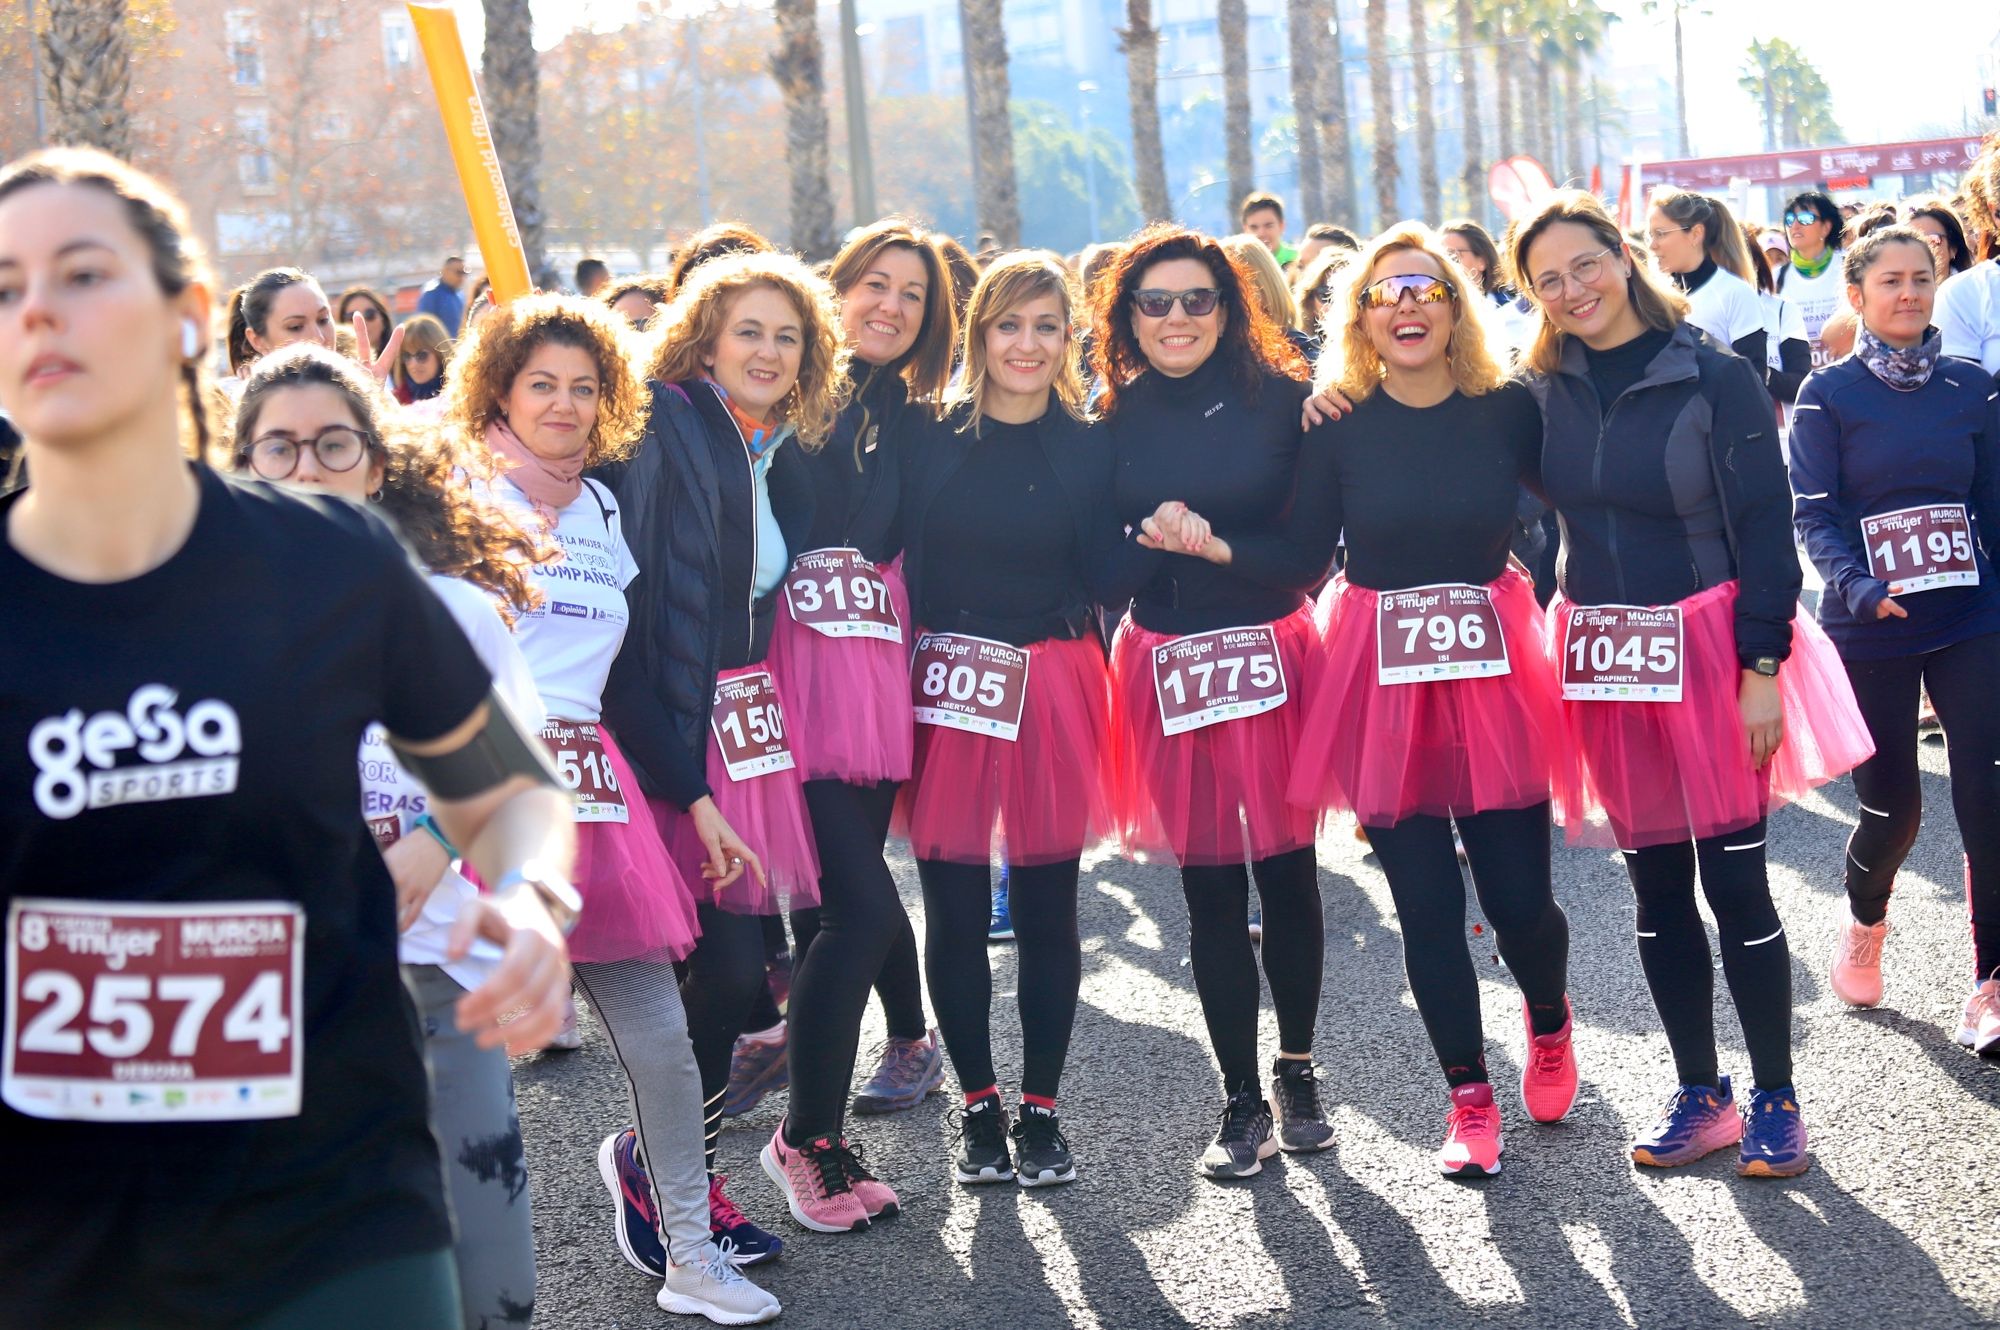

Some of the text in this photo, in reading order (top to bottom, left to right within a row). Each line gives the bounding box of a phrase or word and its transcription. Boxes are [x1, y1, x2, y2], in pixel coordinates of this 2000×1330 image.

[1930, 509, 1962, 519] MURCIA
[1887, 515, 1922, 533] mujer
[1874, 531, 1971, 572] 1195
[807, 557, 844, 573] mujer
[1927, 566, 1937, 574] JU
[792, 576, 887, 614] 3197
[1396, 592, 1420, 600] carrera
[1402, 595, 1440, 613] mujer
[1589, 615, 1618, 632] mujer
[1627, 611, 1675, 622] MURCIA
[1222, 632, 1268, 644] MURCIA
[1397, 613, 1486, 654] 796
[935, 641, 970, 660] mujer
[980, 645, 1023, 664] MURCIA
[1169, 641, 1192, 652] carrera
[1176, 642, 1214, 660] mujer
[1570, 635, 1677, 673] 1045
[991, 657, 1011, 666] MARZO
[721, 681, 745, 693] carrera
[923, 662, 1007, 707] 805
[1163, 654, 1278, 705] 1775
[1594, 675, 1639, 683] CHAPINETA
[730, 684, 760, 704] mujer
[1206, 694, 1239, 707] GERTRU
[936, 700, 977, 714] LIBERTAD
[542, 728, 576, 746] mujer
[557, 750, 618, 792] 518
[99, 768, 227, 804] SPORTS
[180, 918, 287, 944] MURCIA
[18, 970, 291, 1058] 2574
